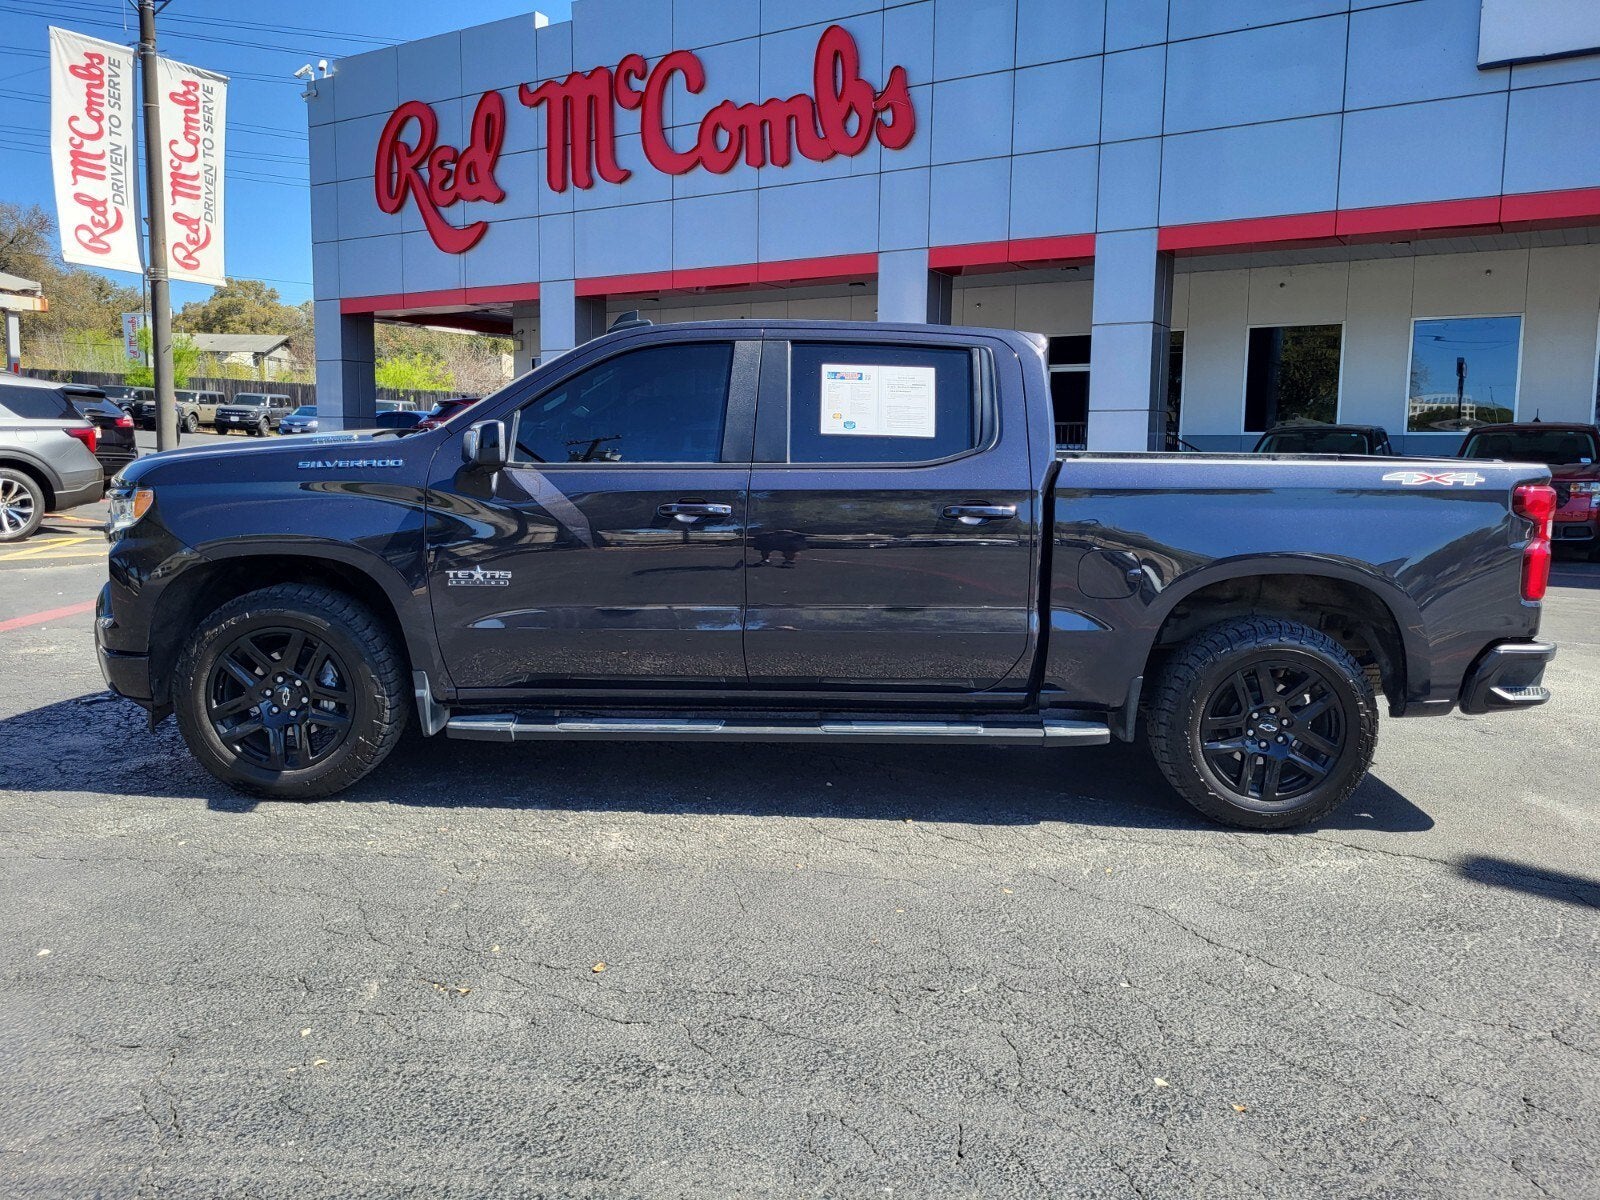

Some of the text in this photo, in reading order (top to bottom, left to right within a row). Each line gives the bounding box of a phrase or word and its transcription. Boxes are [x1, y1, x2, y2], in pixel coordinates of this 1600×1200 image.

[67, 51, 124, 255] Red McCombs
[106, 55, 126, 207] DRIVEN TO SERVE
[168, 79, 212, 271] Red McCombs
[202, 83, 215, 224] DRIVEN TO SERVE
[374, 24, 916, 255] Red McCombs
[297, 459, 404, 469] SILVERADO
[445, 566, 512, 580] TEXAS
